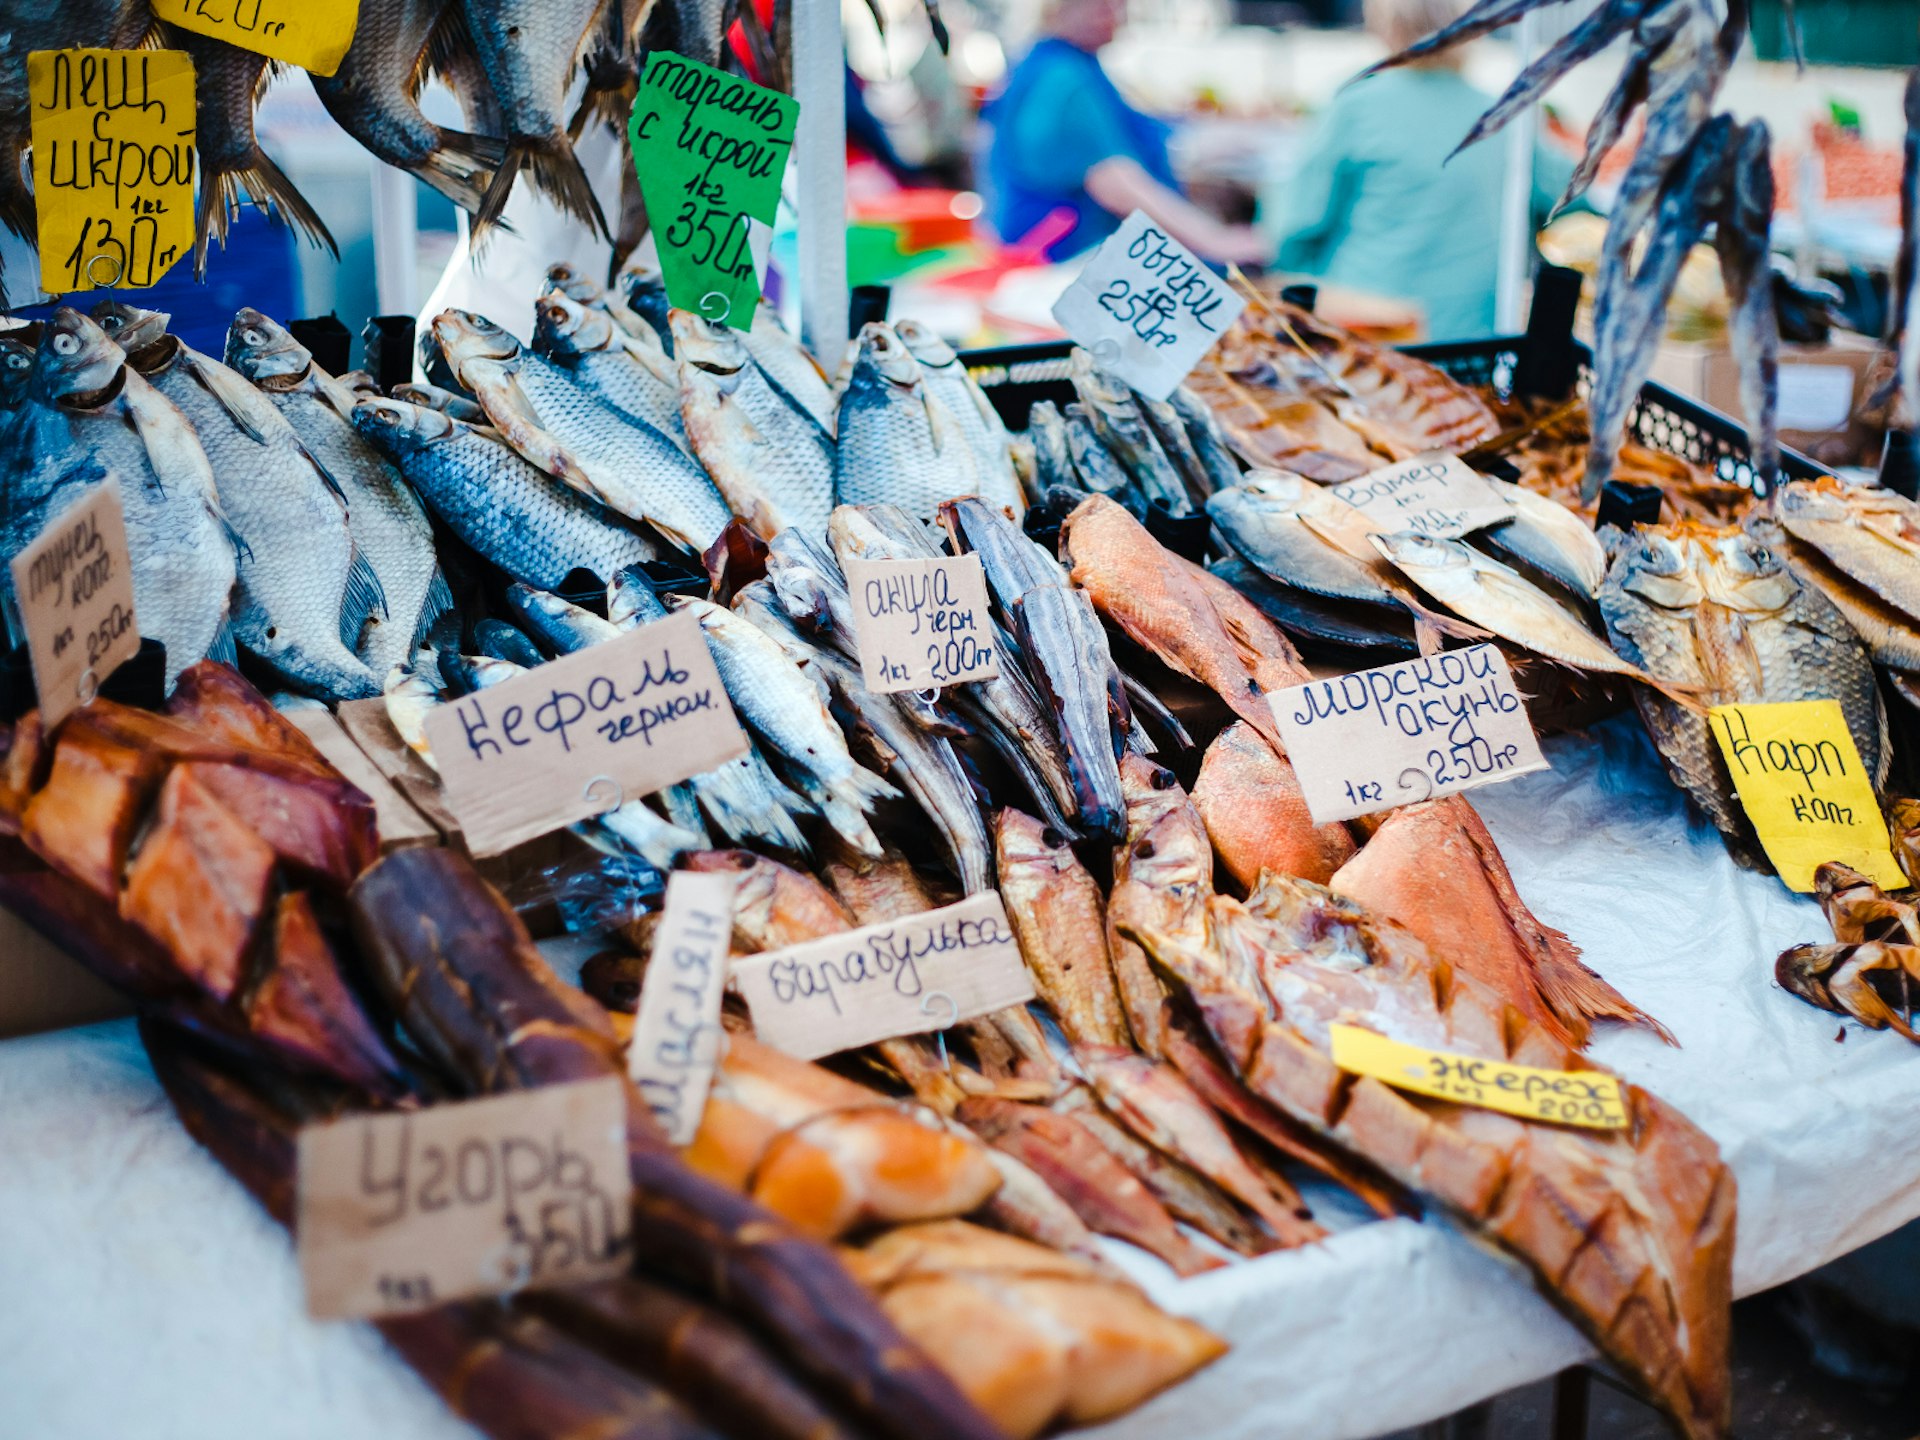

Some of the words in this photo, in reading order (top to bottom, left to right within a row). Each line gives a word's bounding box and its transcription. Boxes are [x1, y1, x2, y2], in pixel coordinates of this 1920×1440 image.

[646, 59, 784, 132] тарань
[637, 111, 661, 139] с
[50, 129, 196, 209] икрой
[130, 196, 169, 214] 1кг
[684, 173, 728, 205] 1кг
[865, 568, 959, 634] акула
[879, 655, 911, 684] 1кг
[1722, 708, 1846, 792] Карп
[1345, 780, 1383, 805] 1кг
